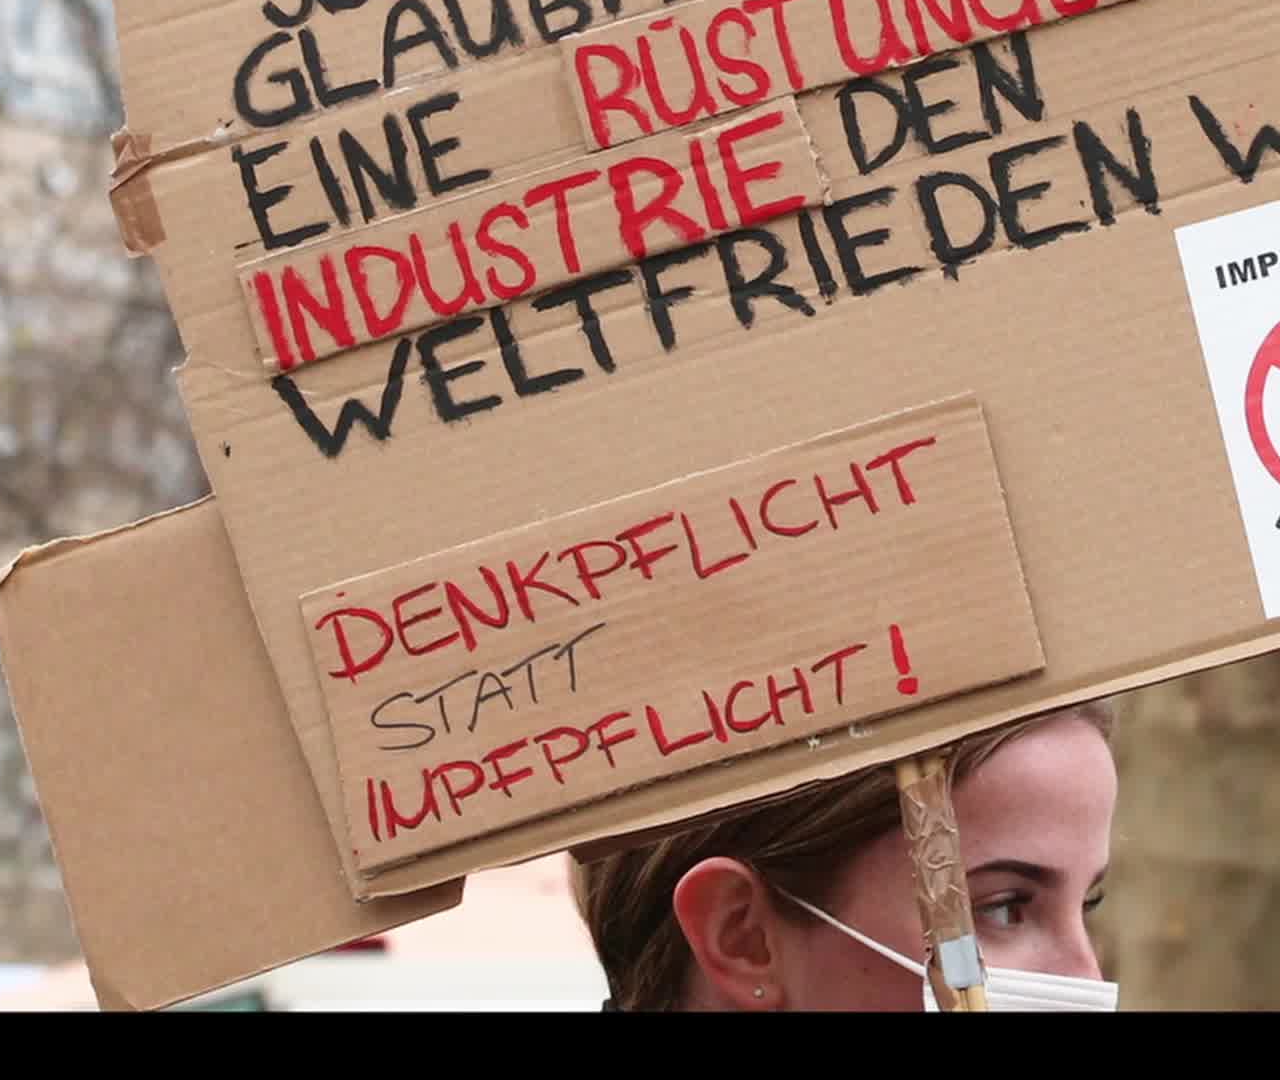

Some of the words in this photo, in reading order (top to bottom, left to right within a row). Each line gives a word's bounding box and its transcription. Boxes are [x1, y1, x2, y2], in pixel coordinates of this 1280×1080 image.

[232, 92, 493, 251] EINE
[250, 108, 807, 370] INDUSTRIE
[833, 32, 1047, 176] DEN
[272, 107, 1162, 457] WELTFRIEDEN
[314, 435, 937, 684] DENKPFLICHT
[369, 621, 607, 752] STATT
